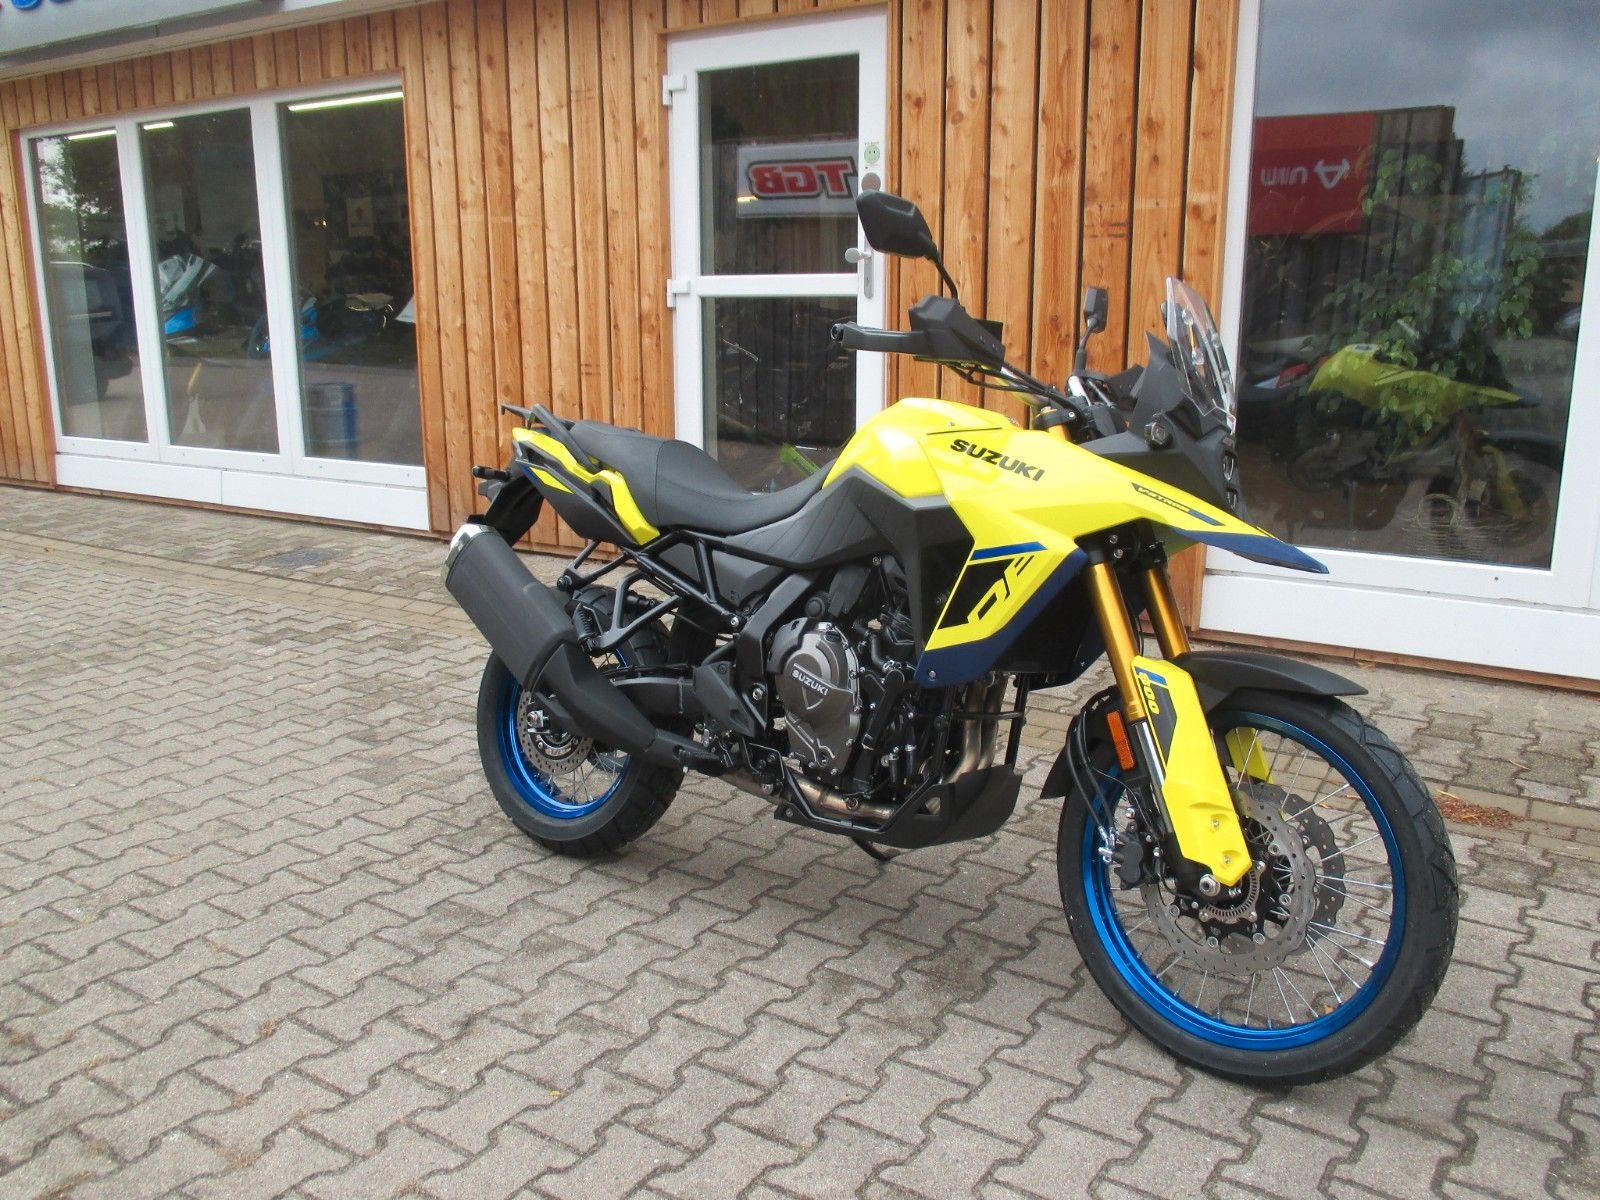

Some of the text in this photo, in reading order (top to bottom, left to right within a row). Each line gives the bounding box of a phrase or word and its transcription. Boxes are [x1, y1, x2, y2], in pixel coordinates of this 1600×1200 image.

[950, 439, 1045, 481] SUZUKI
[792, 669, 829, 696] SUZUKI
[1138, 671, 1160, 715] 800
